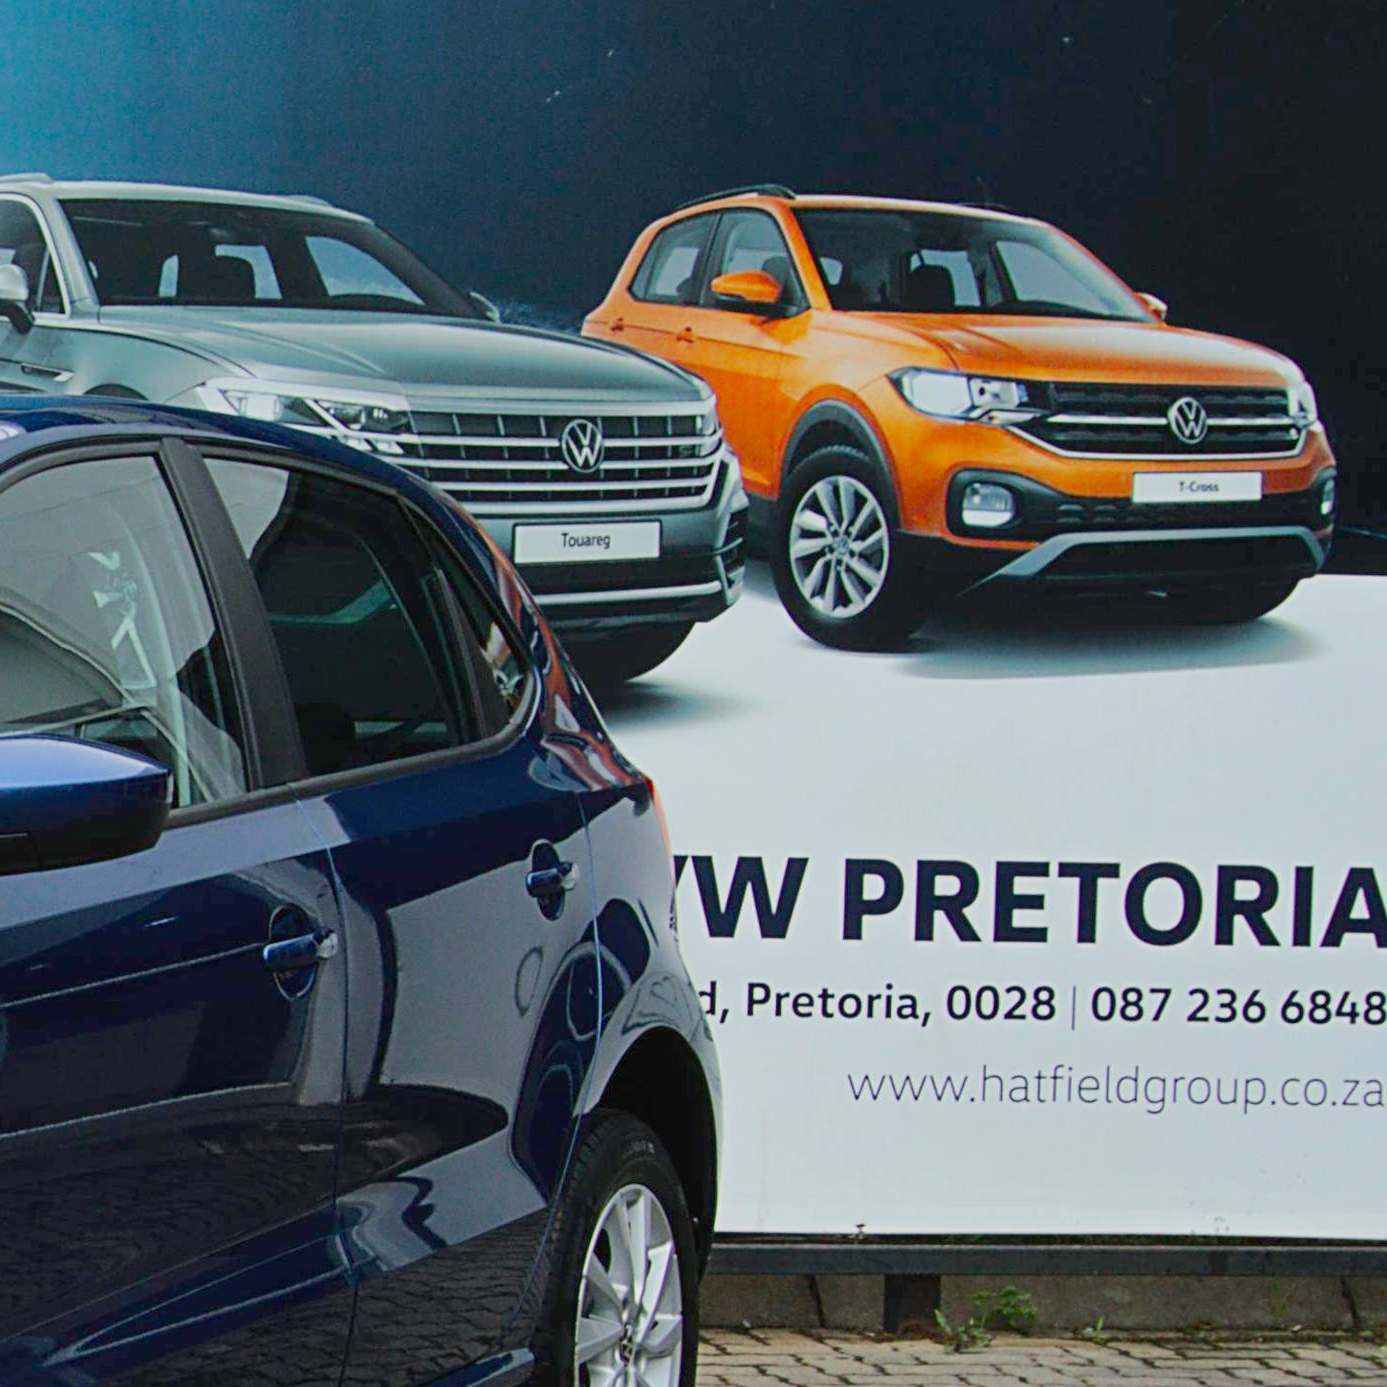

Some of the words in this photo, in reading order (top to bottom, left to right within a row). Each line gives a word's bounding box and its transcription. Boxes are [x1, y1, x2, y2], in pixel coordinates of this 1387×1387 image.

[560, 532, 612, 550] Touareg
[673, 854, 810, 939] W
[842, 857, 1387, 949] PRETORIA
[746, 982, 932, 1029] Pretoria,
[946, 985, 1056, 1021] 0028
[1091, 987, 1172, 1022] 087
[1187, 988, 1266, 1024] 236
[1280, 990, 1387, 1026] 6848
[847, 1064, 1385, 1116] www.hatfieldgroup.co.za
